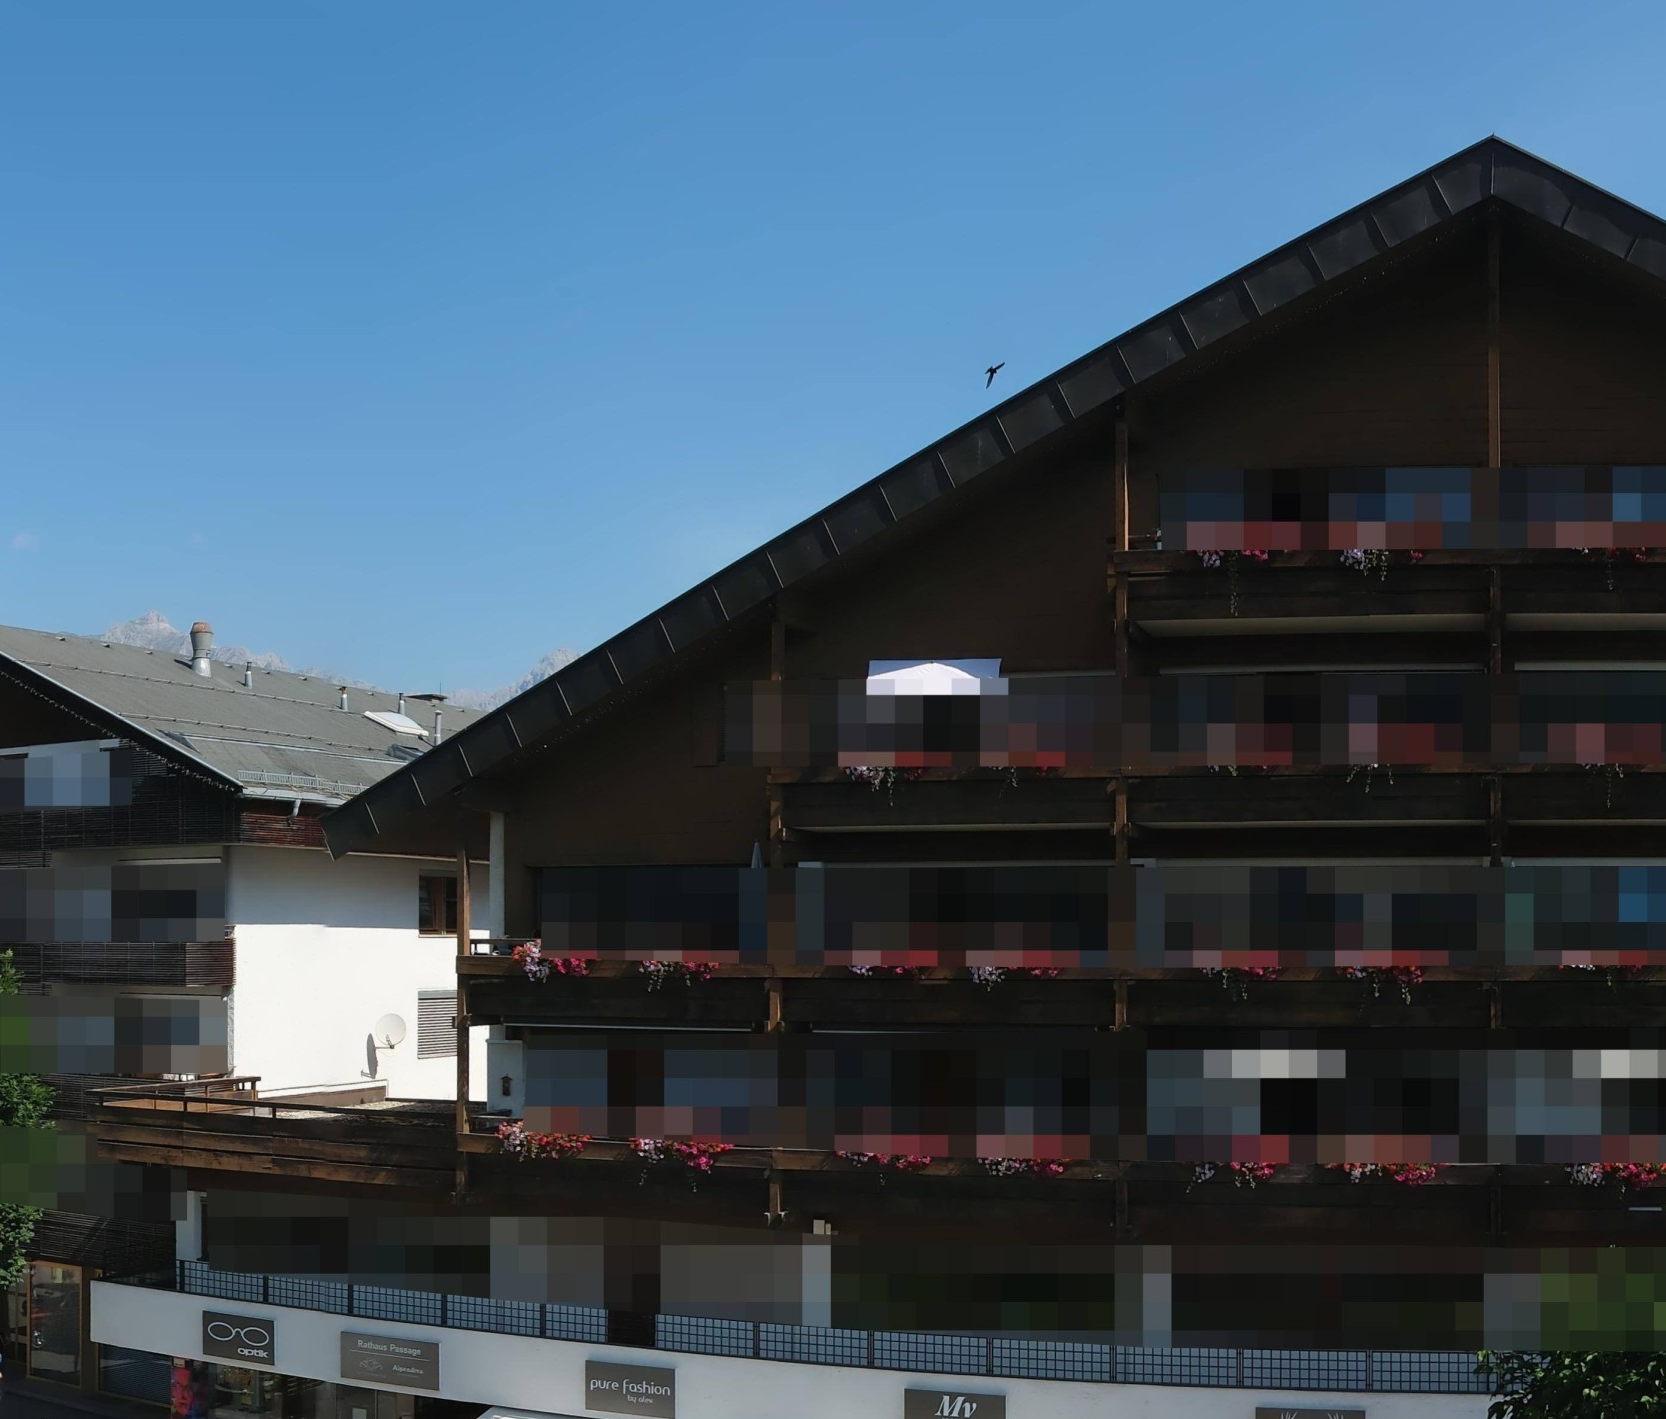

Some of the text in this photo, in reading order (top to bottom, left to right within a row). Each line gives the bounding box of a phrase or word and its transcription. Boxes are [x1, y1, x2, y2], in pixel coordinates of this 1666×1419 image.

[237, 1347, 269, 1359] optik
[357, 1339, 422, 1356] Rathaus Passage
[590, 1379, 671, 1396] pure fashion
[627, 1394, 637, 1404] by
